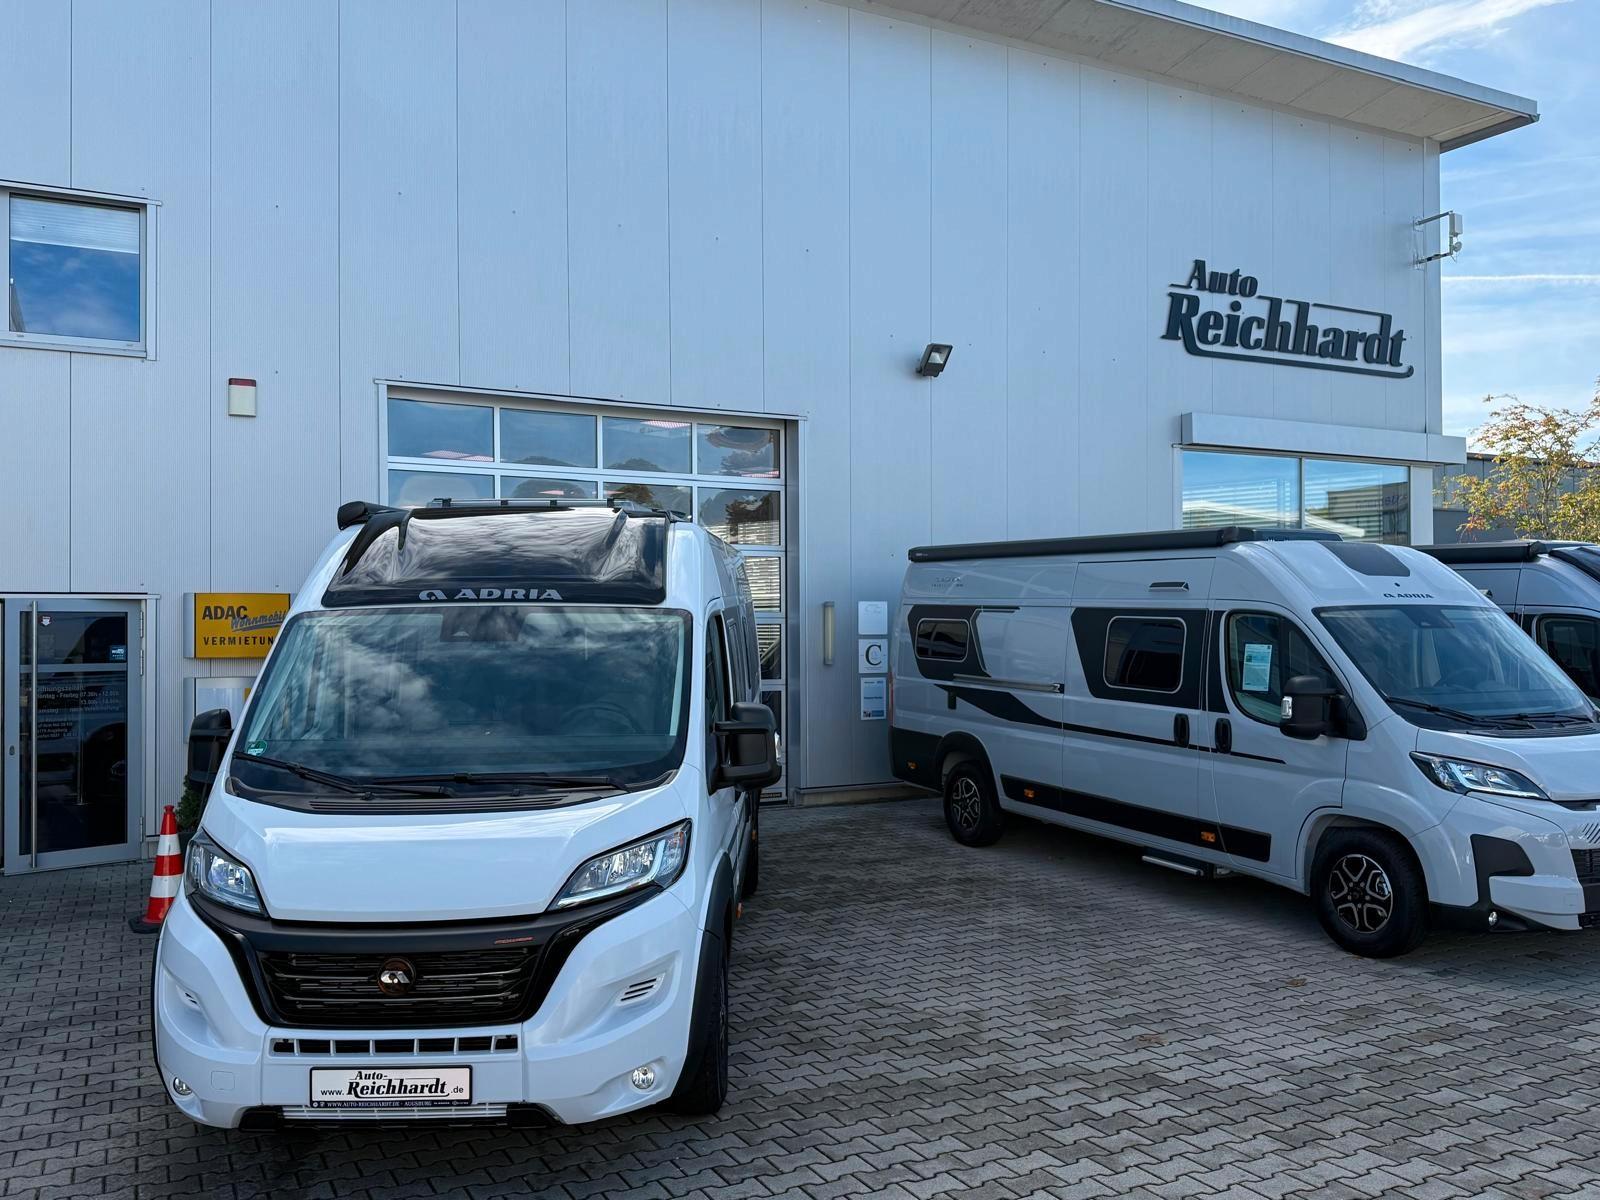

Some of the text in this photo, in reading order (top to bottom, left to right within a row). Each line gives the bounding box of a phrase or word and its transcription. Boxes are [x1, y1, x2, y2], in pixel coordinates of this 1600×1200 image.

[1187, 259, 1258, 298] Auto
[1160, 291, 1411, 375] Reichhardt
[453, 588, 563, 600] ADRIA
[202, 605, 248, 620] ADAC
[203, 636, 275, 646] VERMIETUN
[865, 644, 883, 667] C
[346, 1077, 448, 1097] Reichhardt
[450, 1085, 464, 1094] .de
